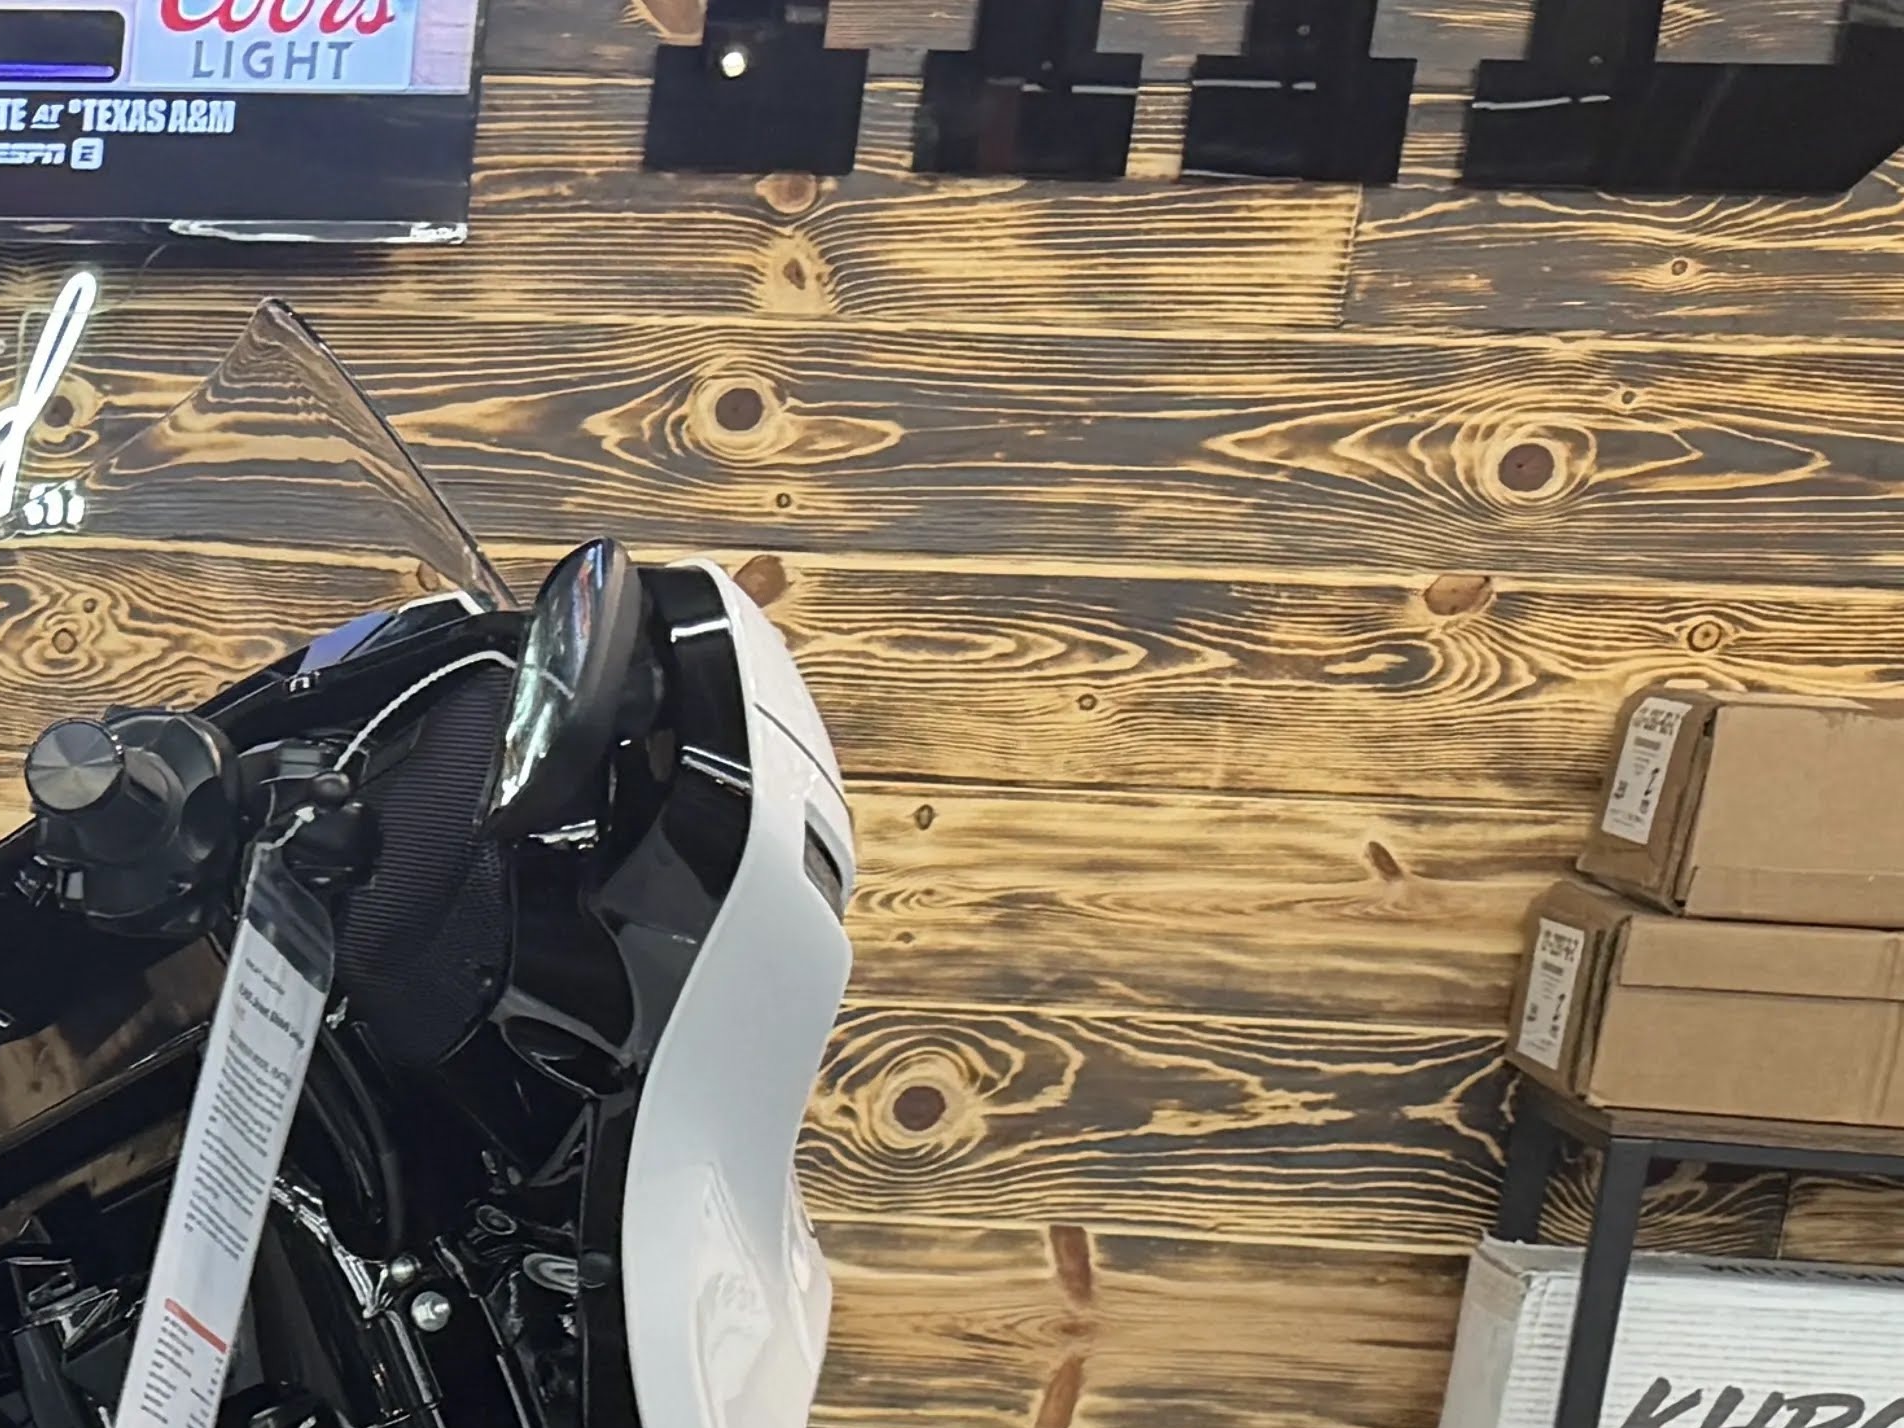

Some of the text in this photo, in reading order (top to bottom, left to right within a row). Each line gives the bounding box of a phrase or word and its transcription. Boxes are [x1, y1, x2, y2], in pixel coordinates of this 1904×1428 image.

[193, 40, 355, 80] LIGHT
[30, 104, 65, 129] AT
[168, 101, 236, 133] A&M
